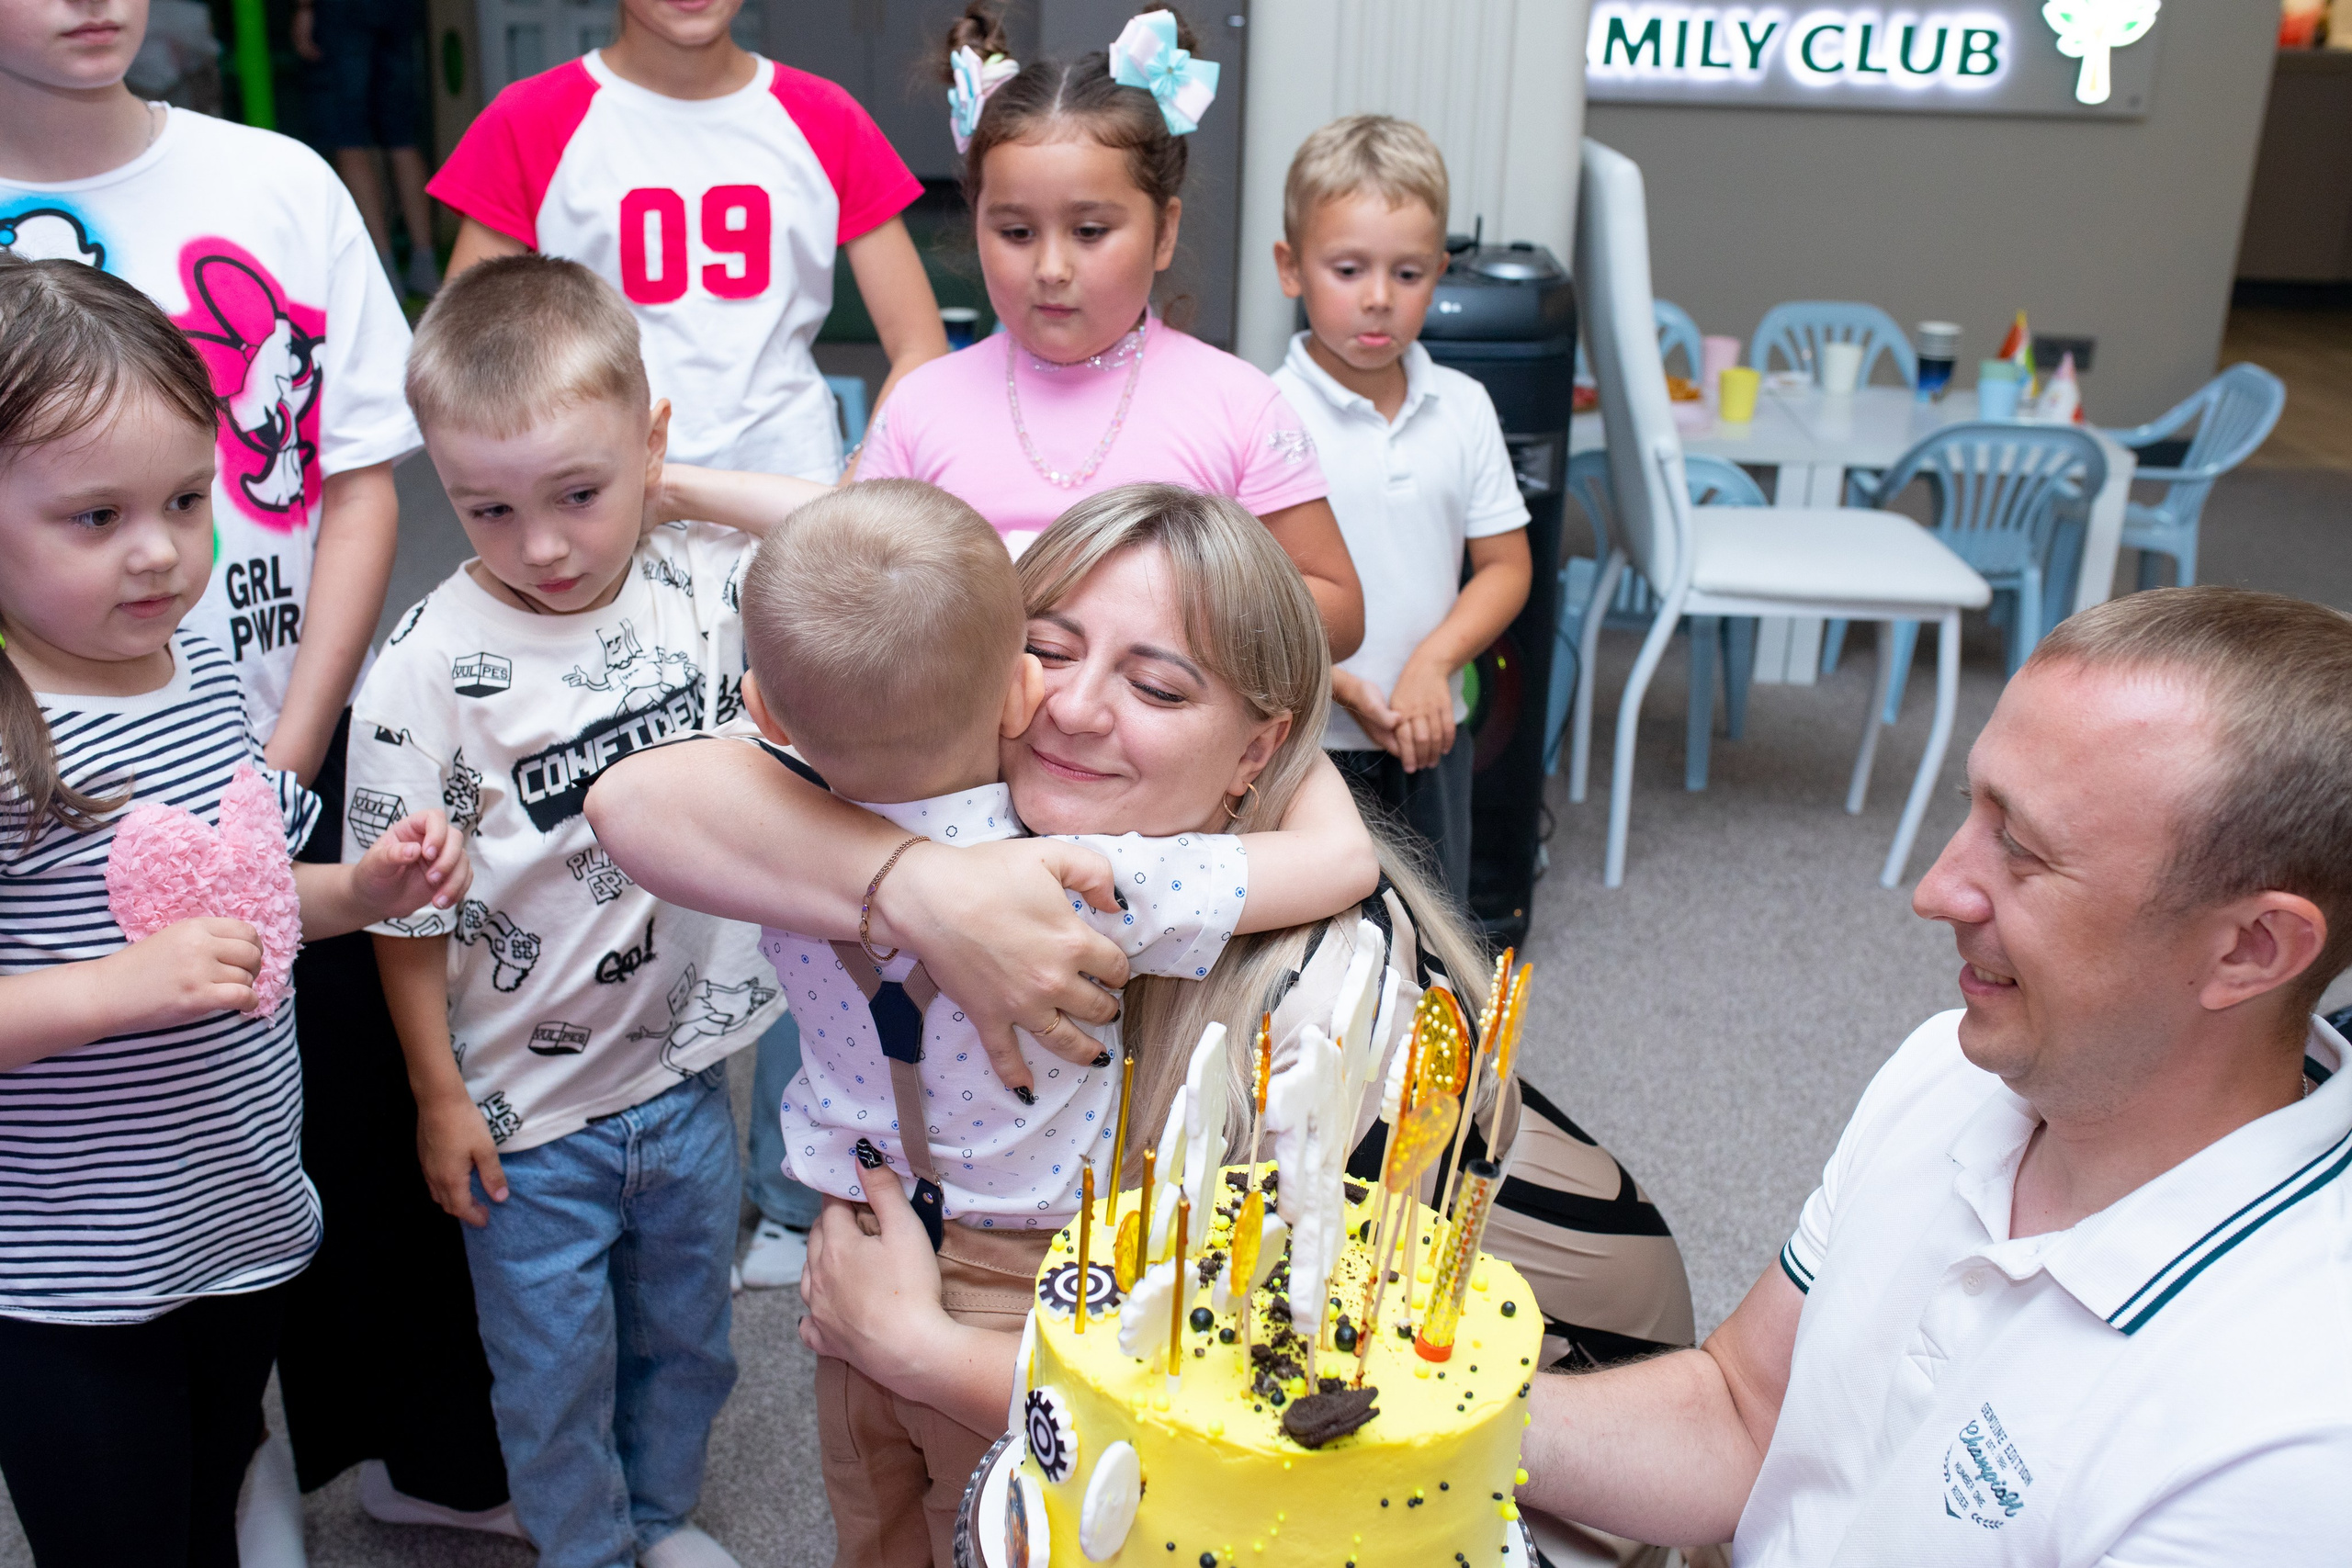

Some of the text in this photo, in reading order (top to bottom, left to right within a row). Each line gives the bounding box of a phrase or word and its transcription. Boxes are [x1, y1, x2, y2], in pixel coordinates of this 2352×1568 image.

[1587, 17, 2000, 76] MILY CLUB
[619, 184, 772, 305] 09
[226, 554, 292, 610] GRL
[230, 603, 300, 661] PWR
[1980, 1402, 2033, 1487] GENUINE EDITION
[1951, 1484, 1969, 1511] RIDER
[1954, 1461, 1986, 1509] NUMBER ONE
